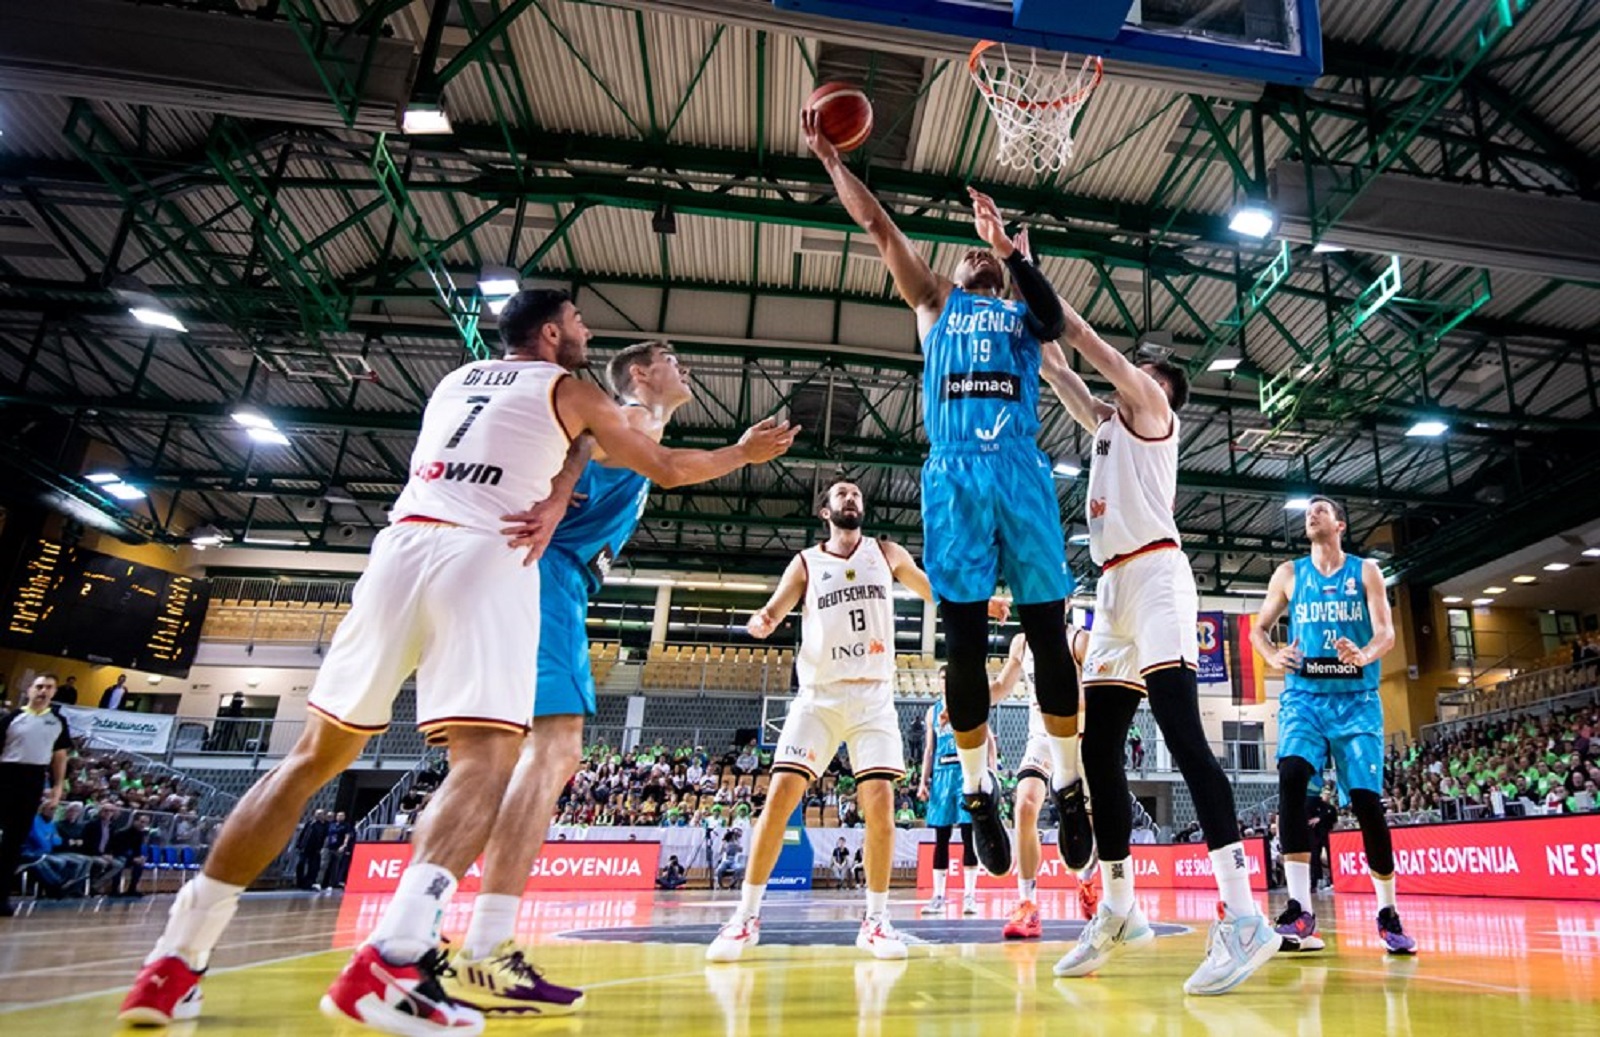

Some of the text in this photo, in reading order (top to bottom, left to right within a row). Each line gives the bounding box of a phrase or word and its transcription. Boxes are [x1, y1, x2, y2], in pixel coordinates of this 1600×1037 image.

[946, 309, 1023, 338] SLOVENIJA
[972, 338, 992, 363] 19
[462, 368, 484, 386] DI
[445, 395, 492, 449] 7
[415, 461, 503, 486] pwin
[80, 582, 92, 596] 2
[817, 584, 887, 610] DEUTSCHLAND
[848, 608, 866, 632] 13
[1295, 602, 1363, 623] SLOVENIJA
[832, 642, 865, 660] ING
[1306, 662, 1358, 674] telemach
[785, 745, 807, 758] ING
[368, 859, 402, 879] NE
[530, 857, 642, 877] SLOVENIJA
[1339, 846, 1519, 875] NE S ARAT SLOVENIJA
[1546, 844, 1579, 877] NE
